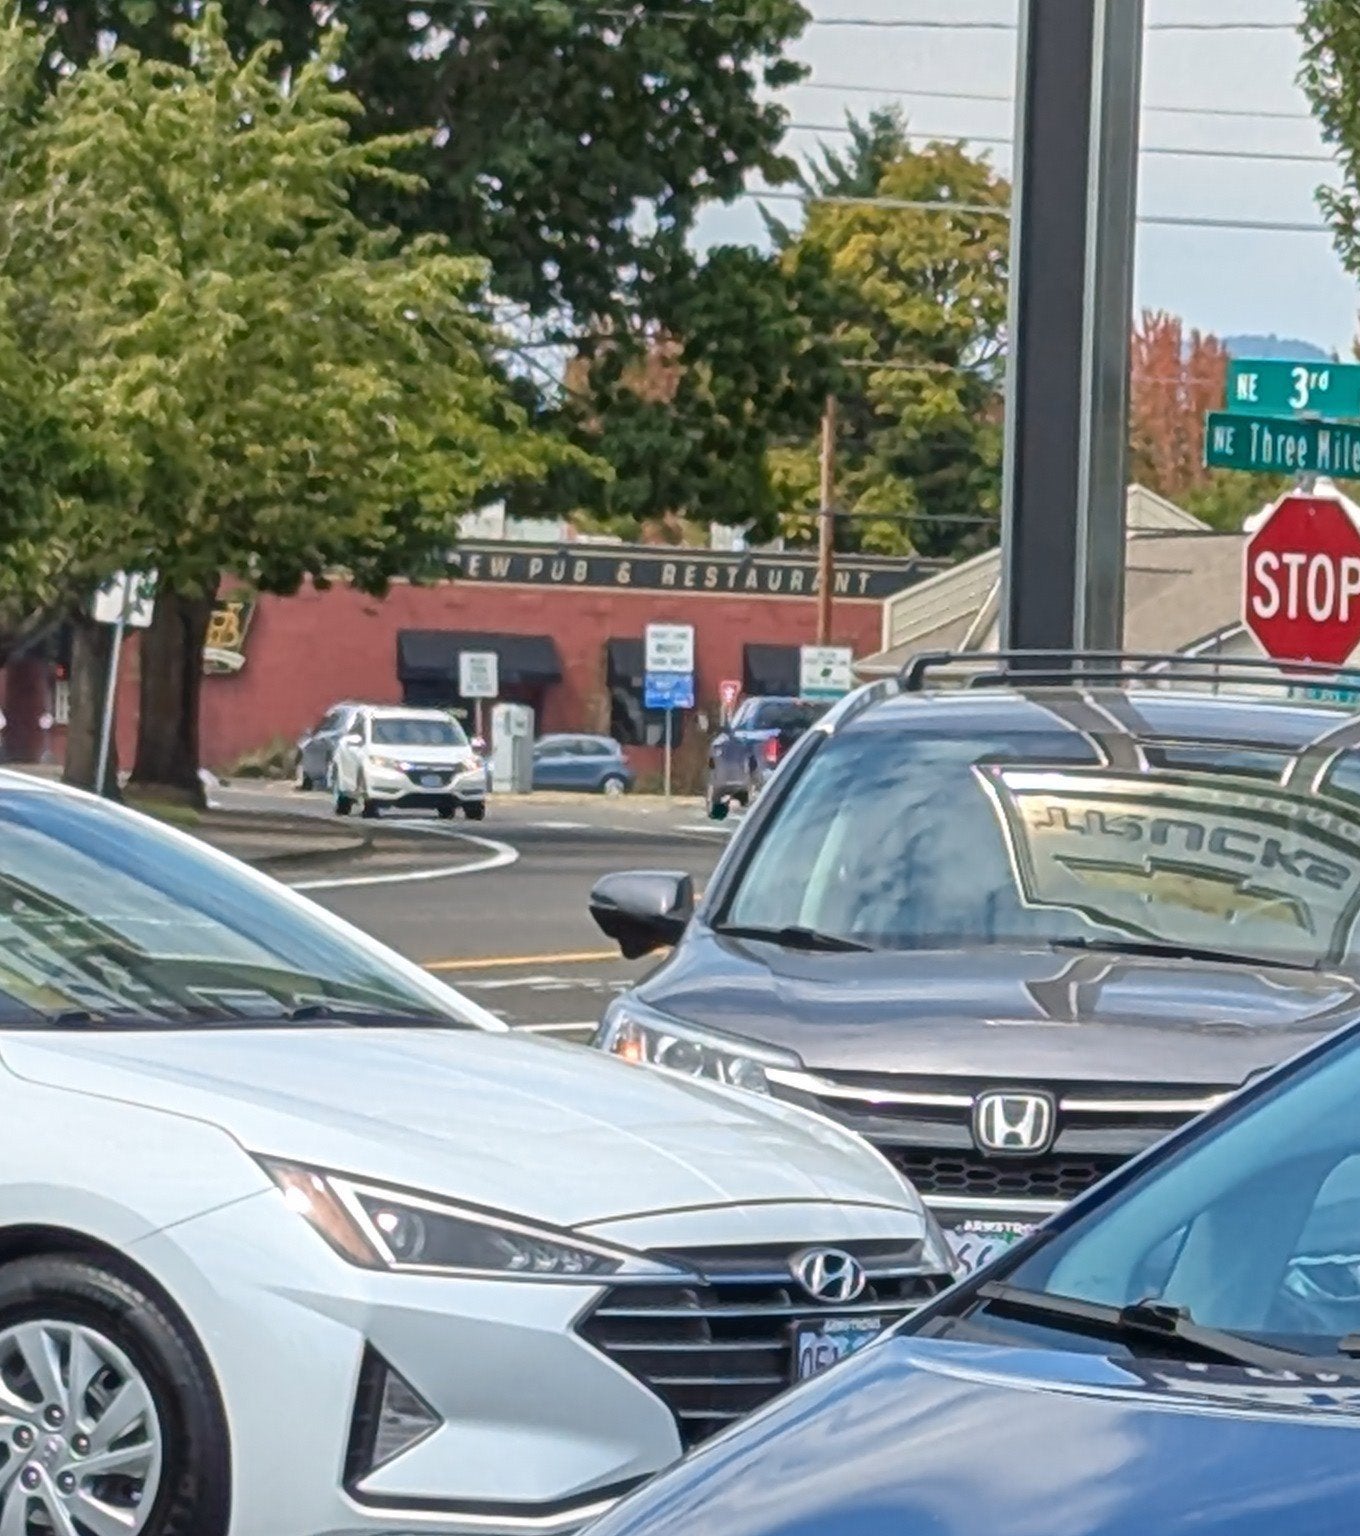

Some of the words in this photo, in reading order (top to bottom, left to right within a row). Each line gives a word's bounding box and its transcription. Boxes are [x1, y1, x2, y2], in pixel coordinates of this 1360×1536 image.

[1236, 373, 1258, 402] NE
[1288, 366, 1330, 409] 3rd
[1213, 425, 1235, 456] NE
[1250, 422, 1308, 467] Three
[529, 557, 588, 582] PUB
[616, 561, 632, 584] &
[660, 563, 872, 594] RESTAURANT
